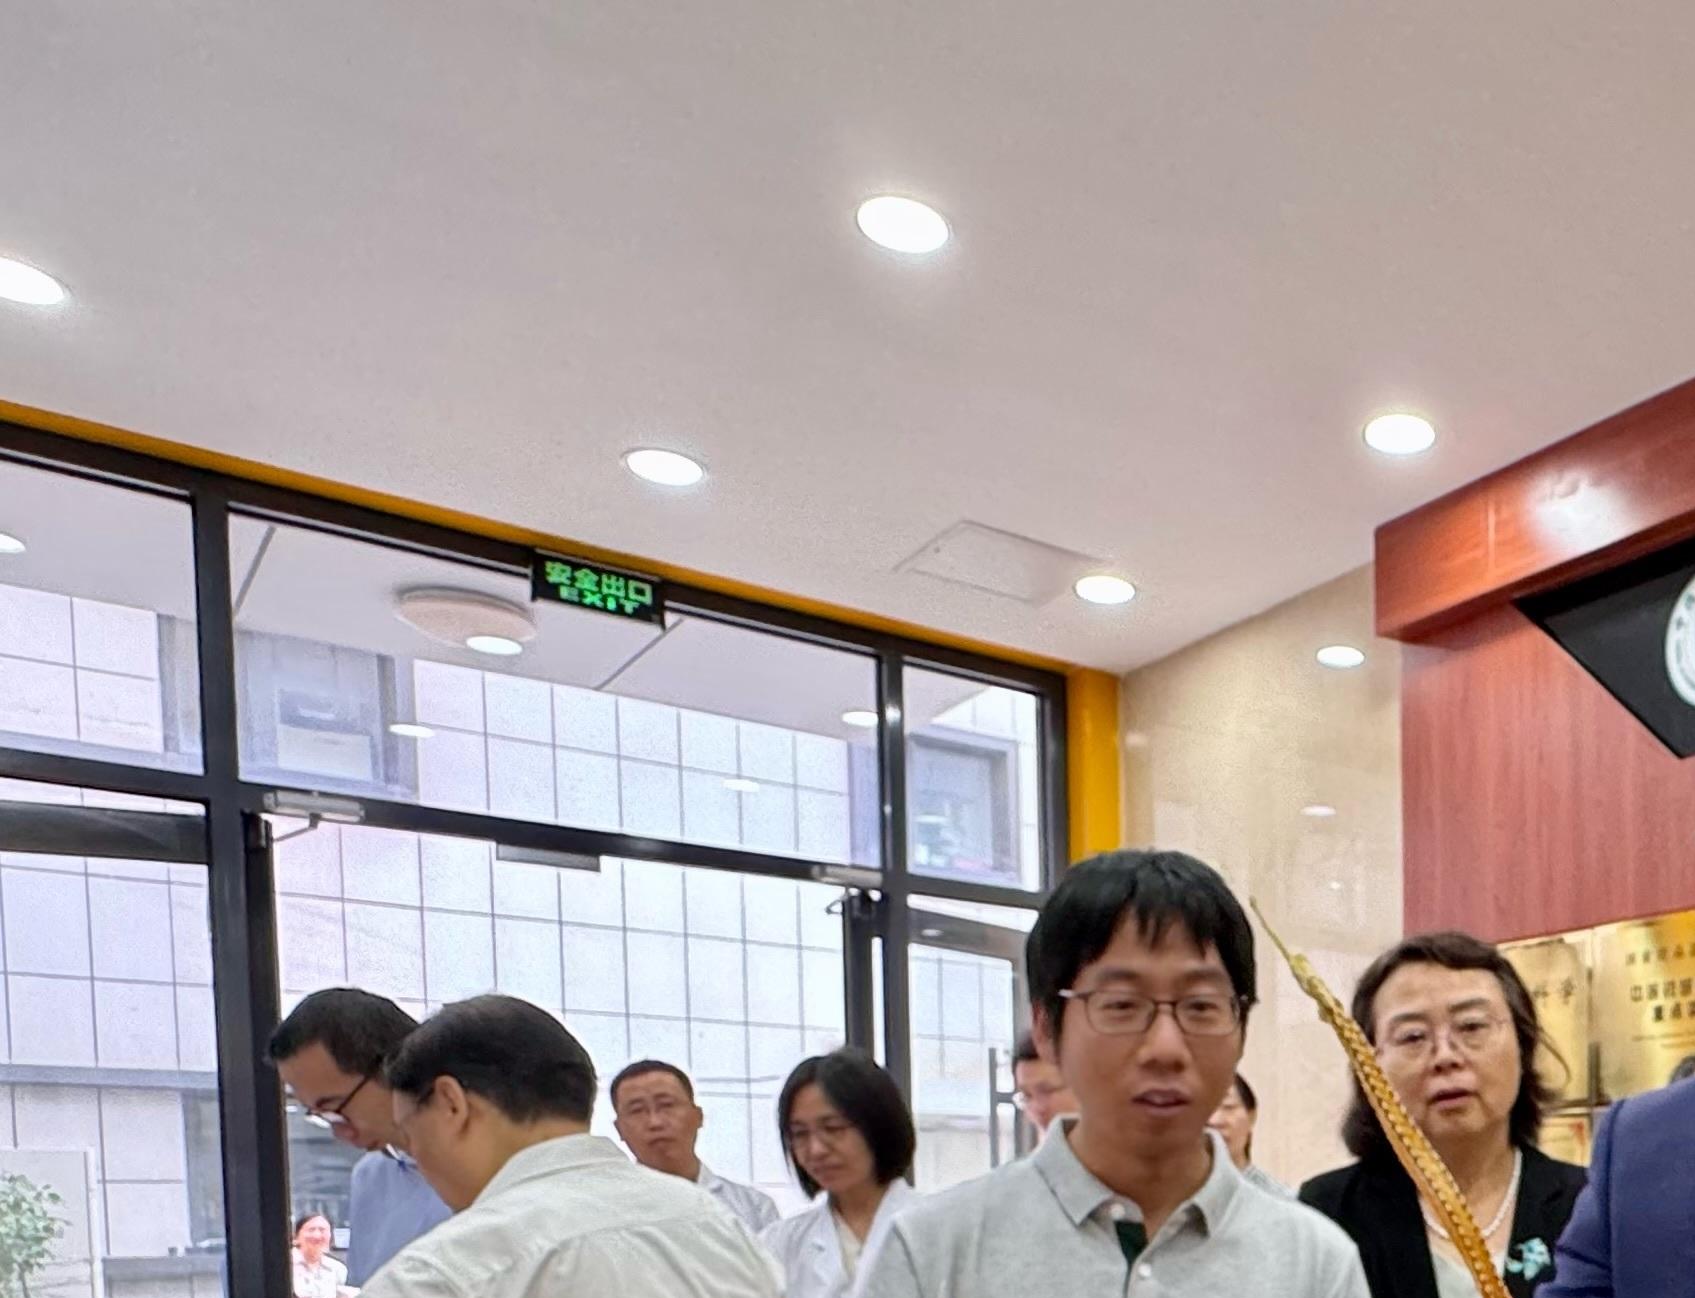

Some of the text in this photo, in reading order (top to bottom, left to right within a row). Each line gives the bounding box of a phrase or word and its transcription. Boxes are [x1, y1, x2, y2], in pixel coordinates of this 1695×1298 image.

[545, 560, 653, 606] 安全出口
[559, 585, 640, 615] EXIT
